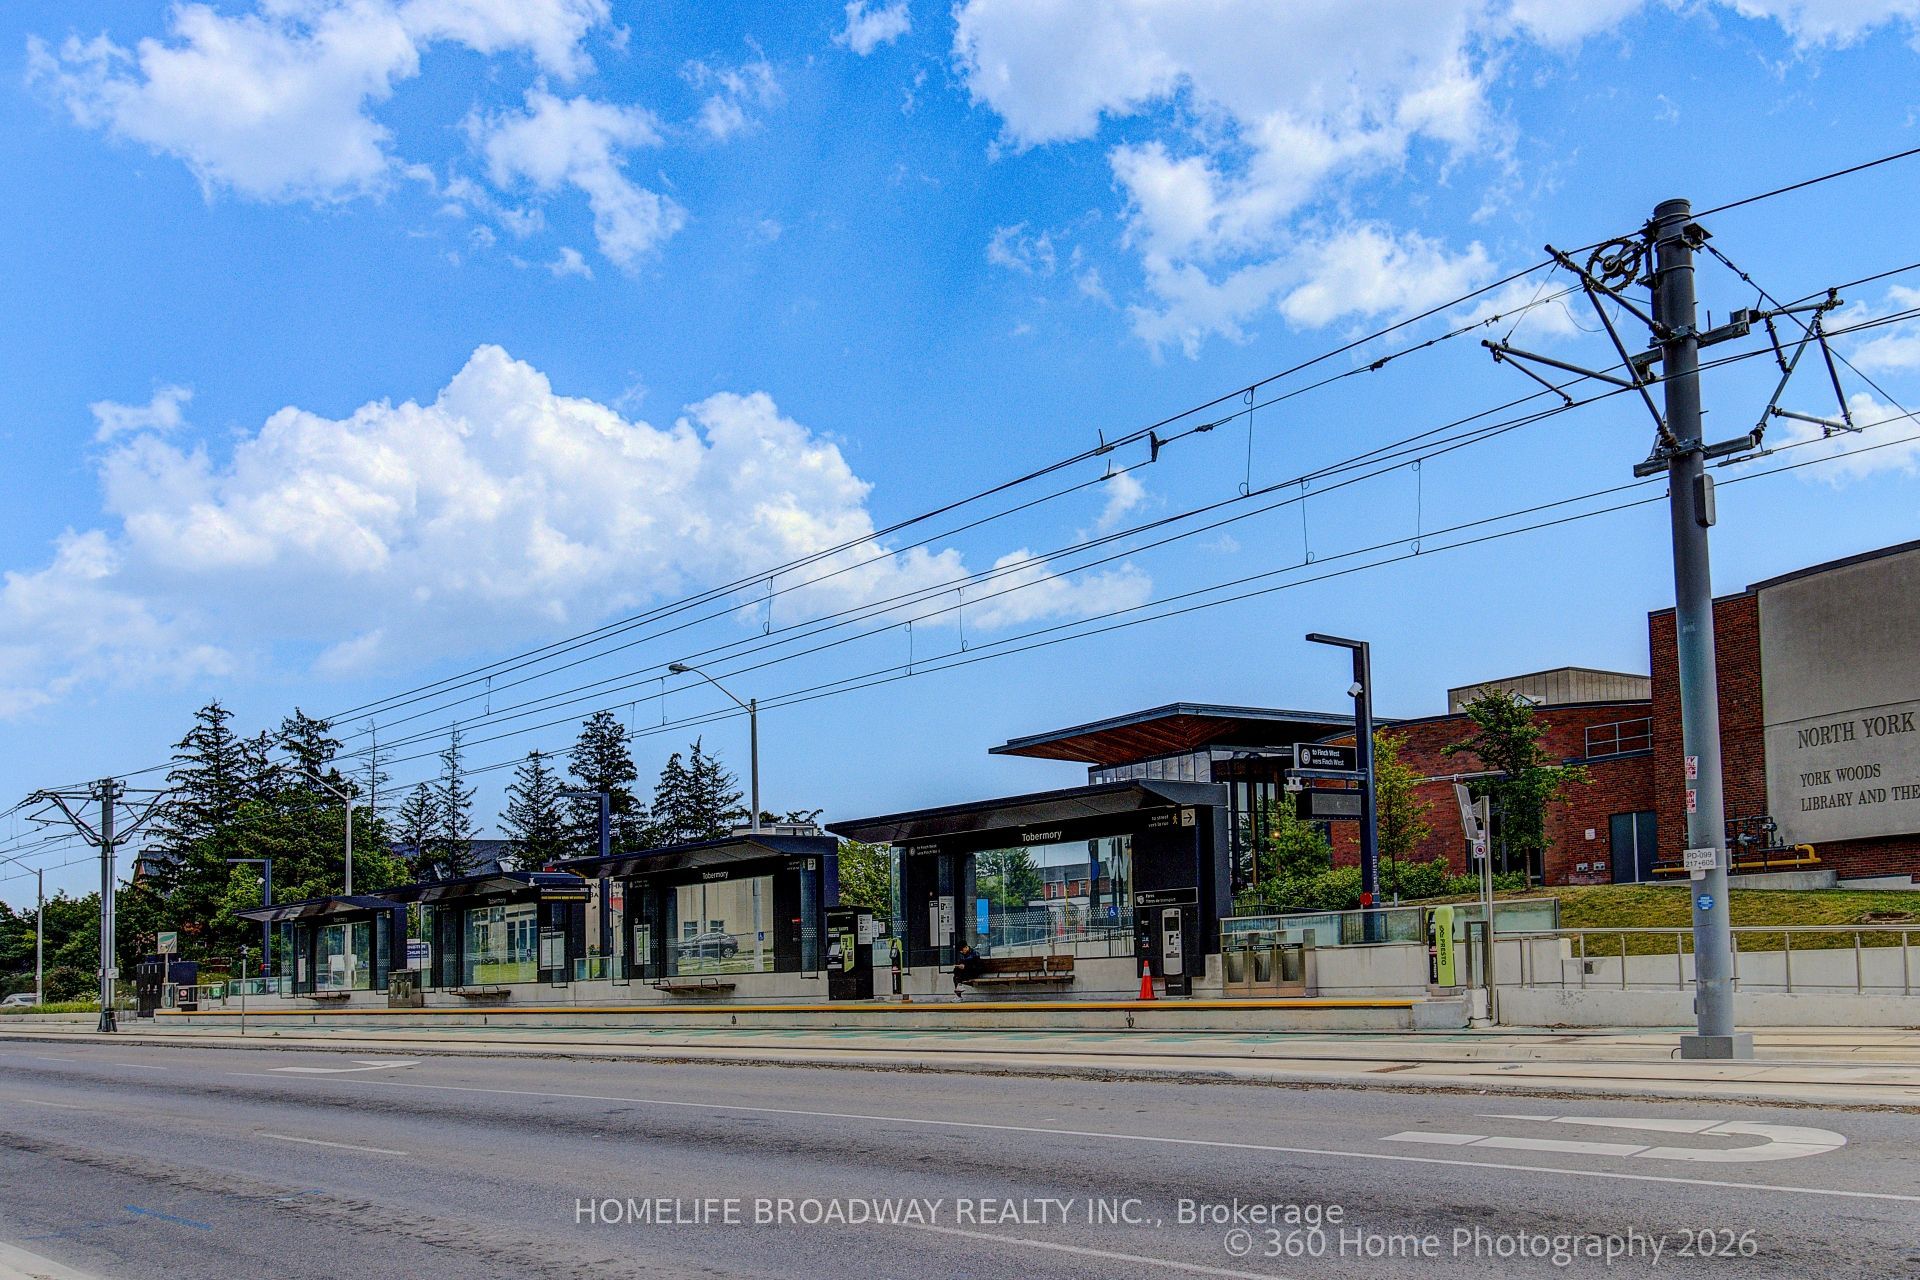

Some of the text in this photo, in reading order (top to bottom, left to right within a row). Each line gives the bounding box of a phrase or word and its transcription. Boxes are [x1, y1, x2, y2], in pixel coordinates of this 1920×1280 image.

[1797, 712, 1916, 749] NORTH YORK
[1800, 763, 1881, 787] YORK WOODS
[1801, 792, 1853, 812] LIBRARY
[1858, 788, 1887, 805] AND
[1022, 831, 1062, 842] Tobermory
[1685, 859, 1714, 867] 217+605
[702, 871, 728, 880] Tobermory
